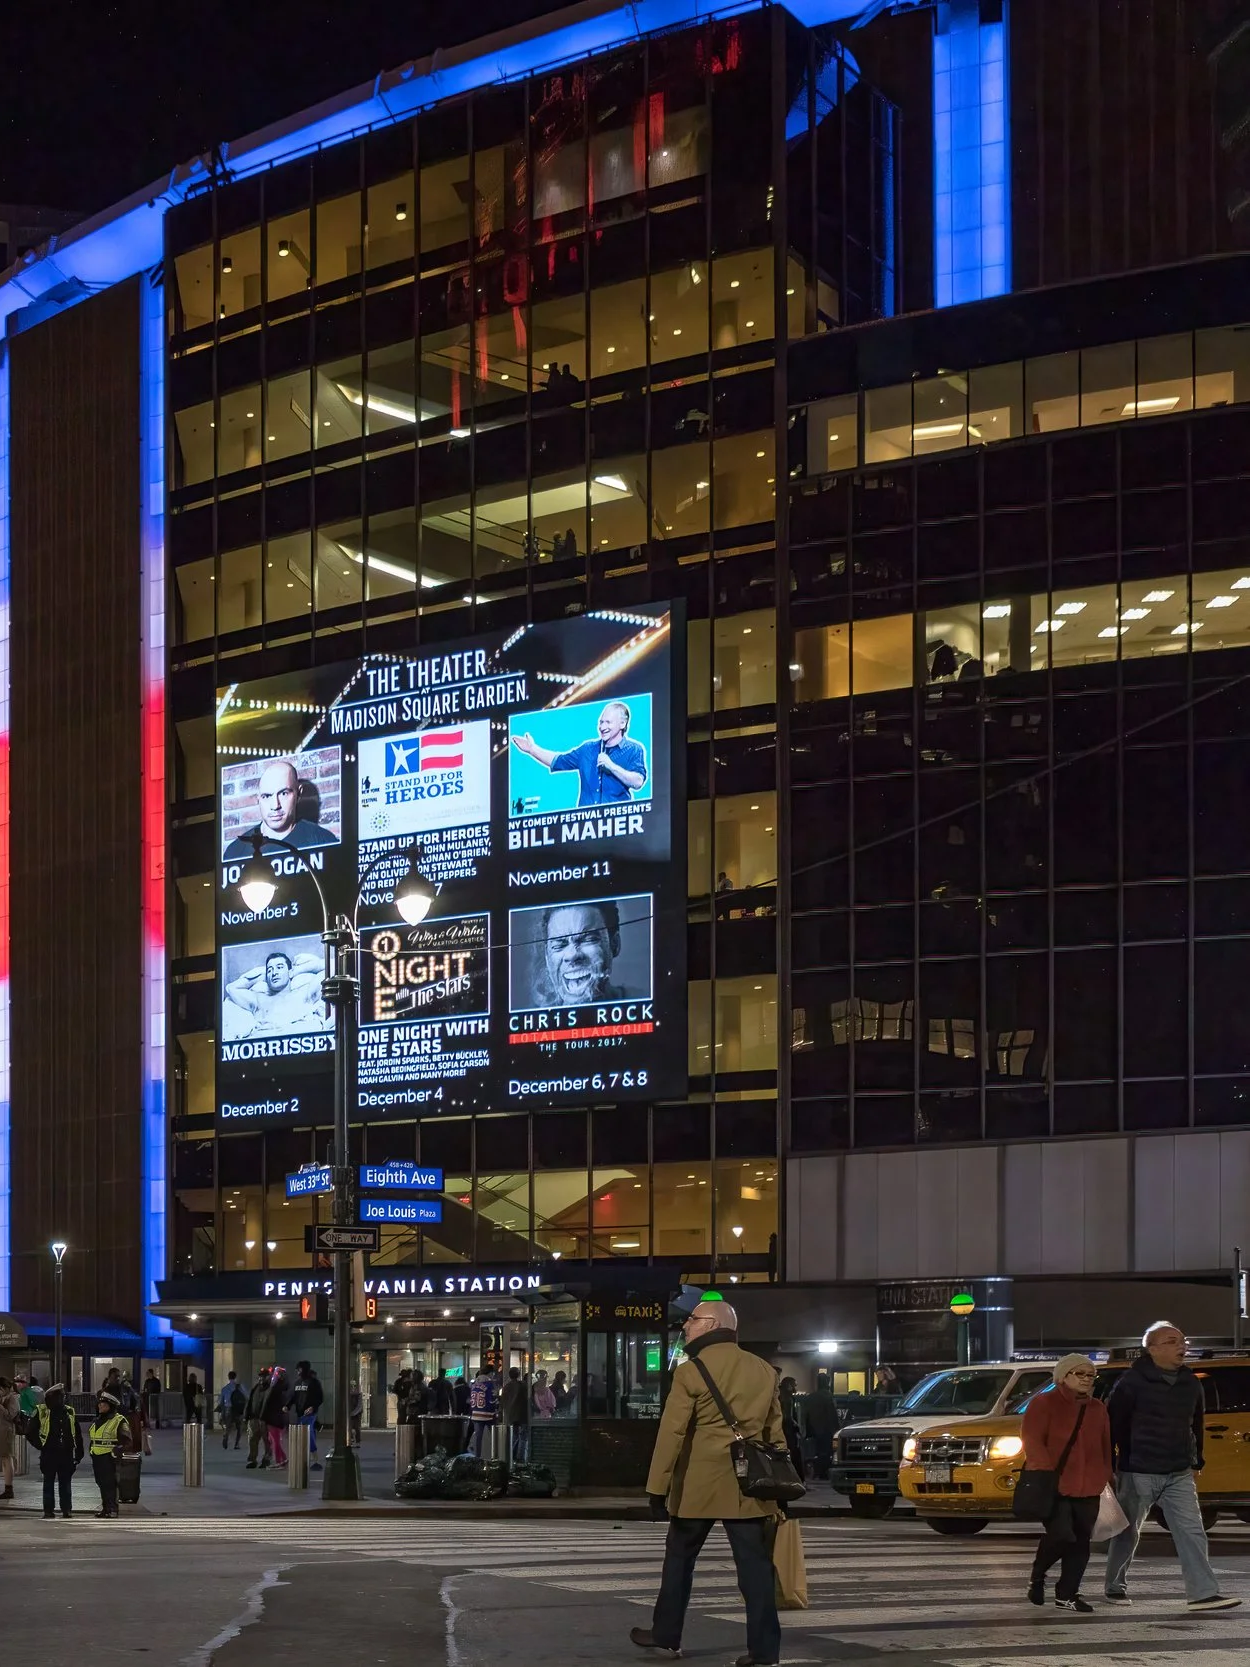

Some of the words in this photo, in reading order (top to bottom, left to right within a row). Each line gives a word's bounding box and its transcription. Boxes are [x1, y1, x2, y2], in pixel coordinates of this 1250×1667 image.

[366, 664, 400, 697] THE
[406, 649, 487, 689] THEATER
[420, 686, 431, 695] AT
[330, 702, 398, 735] MADISON
[401, 691, 460, 722] SQUARE
[385, 777, 421, 790] STAND
[423, 774, 438, 784] UP
[440, 770, 463, 782] FOR
[384, 779, 464, 805] HEROES
[508, 819, 521, 831] NY
[522, 814, 559, 829] COMEDY
[560, 811, 603, 824] FESTIVAL
[603, 802, 652, 817] PRESENTS
[358, 838, 396, 855] STAND
[398, 835, 414, 848] UP
[416, 831, 440, 846] FOR
[442, 825, 490, 842] HEROES
[508, 826, 555, 851] BILL
[561, 814, 645, 844] MAHER
[358, 850, 387, 863] HASA
[447, 838, 492, 851] MULANEY,
[222, 864, 245, 889] JO
[271, 851, 324, 876] OGAN
[358, 860, 391, 873] TRVOR
[431, 858, 473, 872] STEWART
[508, 865, 589, 887] November
[592, 861, 611, 877] 11
[377, 878, 395, 889] RED
[437, 867, 477, 881] PEPPERS
[357, 891, 394, 907] Nove
[221, 904, 289, 926] November
[290, 902, 299, 916] 3
[374, 951, 471, 988] NIGHT
[409, 987, 434, 1008] The
[436, 972, 471, 999] Stars
[596, 1003, 654, 1024] ROCK
[357, 1028, 390, 1045] ONE
[393, 1023, 442, 1042] NIGHT
[445, 1018, 489, 1037] WITH
[510, 1031, 556, 1044] TOTAL
[571, 1022, 654, 1039] BLACKOUT
[357, 1043, 388, 1060] THE
[391, 1038, 442, 1057] STARS
[539, 1042, 558, 1052] THE
[357, 1059, 376, 1069] FEAT.
[376, 1057, 401, 1068] JORDIN
[401, 1054, 432, 1065] SPARKS,
[432, 1052, 455, 1062] BETTY
[455, 1049, 489, 1060] BUCKLEY,
[357, 1066, 390, 1077] NATASHA
[390, 1062, 437, 1074] BEDINGFIELD,
[437, 1060, 459, 1070] SOFIA
[459, 1058, 490, 1068] CARSON
[357, 1076, 378, 1085] NOAH
[378, 1074, 404, 1083] GALVIN
[404, 1073, 420, 1081] AND
[420, 1070, 442, 1080] MANY
[442, 1068, 467, 1078] MORE!
[508, 1076, 589, 1096] December
[591, 1073, 606, 1091] 6,
[609, 1073, 619, 1088] 7
[621, 1071, 634, 1087] &
[636, 1071, 648, 1087] 8
[358, 1088, 432, 1107] December
[433, 1086, 443, 1100] 4
[221, 1099, 289, 1118] December
[290, 1097, 299, 1112] 2
[289, 1177, 307, 1193] West
[307, 1173, 321, 1189] 33rd
[321, 1172, 330, 1186] St
[366, 1169, 408, 1187] Eighth
[410, 1171, 436, 1185] Ave
[366, 1203, 385, 1218] Joe
[387, 1204, 417, 1219] Louis
[419, 1209, 436, 1219] Plaza
[325, 1233, 343, 1243] ONE
[350, 1233, 369, 1243] WAY
[444, 1275, 541, 1293] STATION
